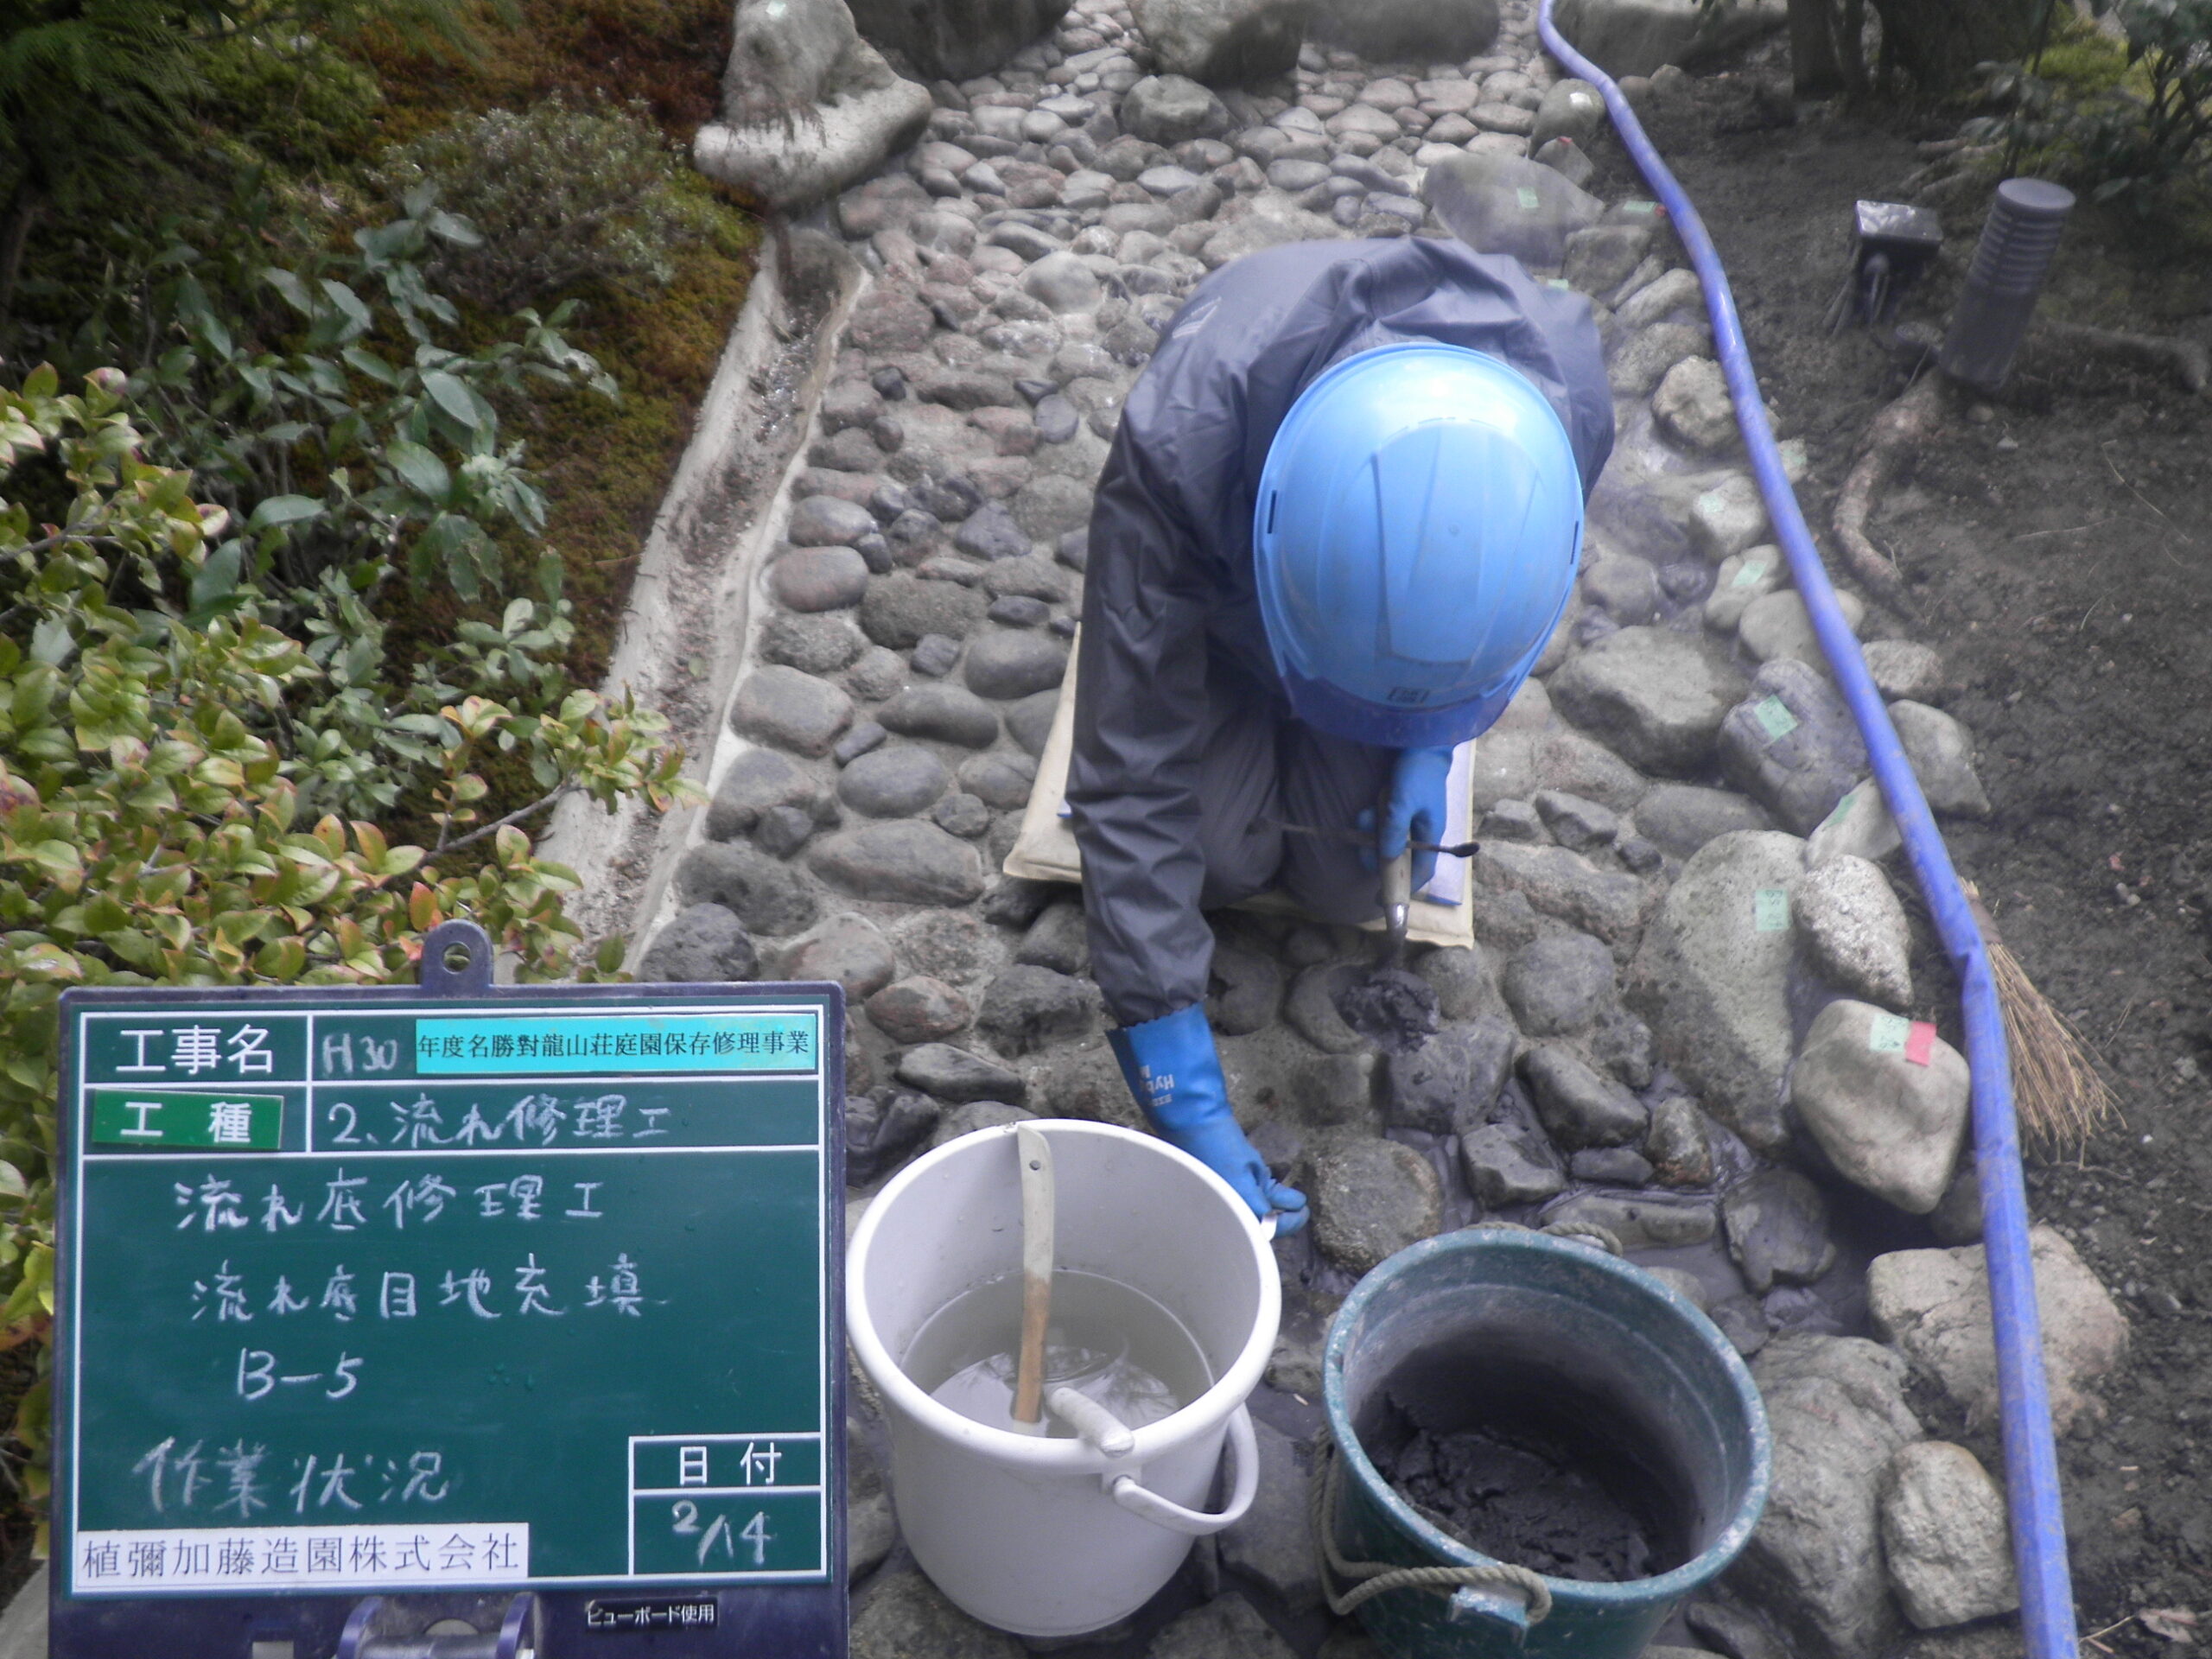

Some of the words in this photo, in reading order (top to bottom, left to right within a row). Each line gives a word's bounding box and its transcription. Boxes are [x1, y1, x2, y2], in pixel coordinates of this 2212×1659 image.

[116, 1024, 272, 1074] 工事名
[322, 1033, 398, 1077] H30
[120, 1100, 252, 1143] 工種
[131, 1435, 449, 1518] 作業状況
[679, 1442, 782, 1486] 日付
[83, 1531, 519, 1580] 植彌加藤造園株式会社
[671, 1499, 777, 1566] 2/14
